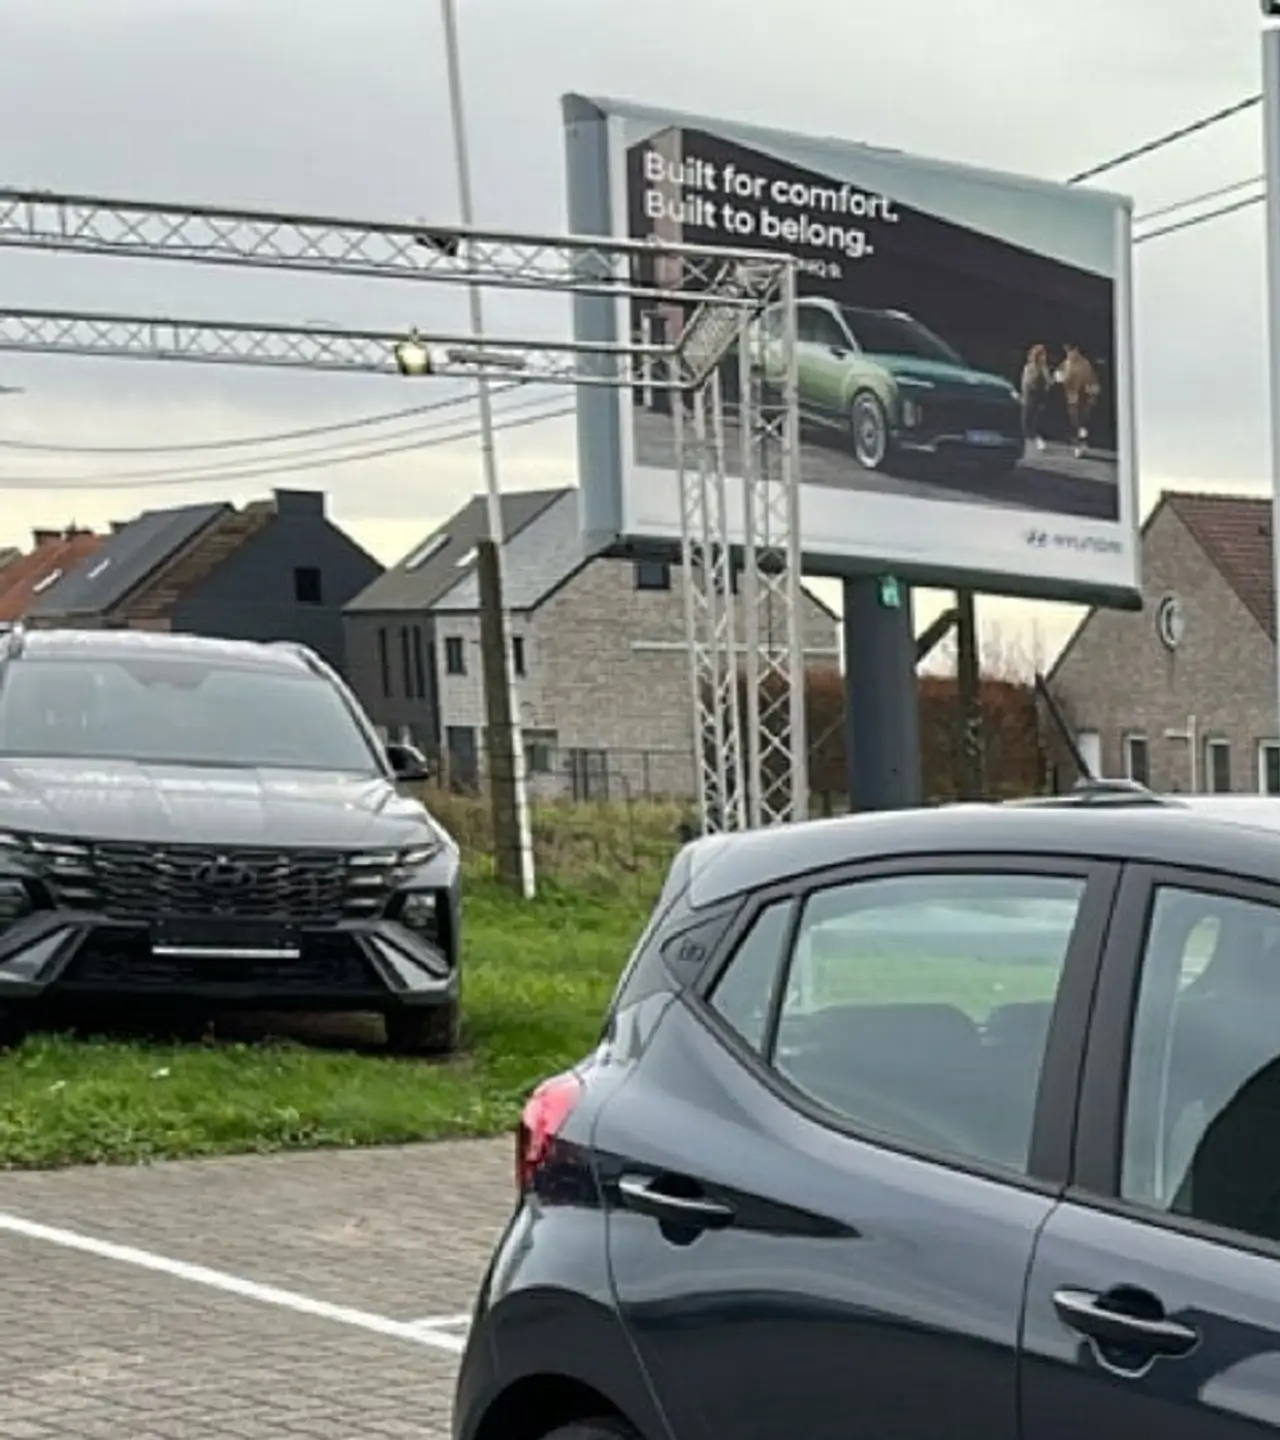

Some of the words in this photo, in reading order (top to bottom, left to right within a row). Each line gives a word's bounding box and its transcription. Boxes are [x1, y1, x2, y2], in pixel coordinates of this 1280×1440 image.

[644, 151, 716, 191] Built
[723, 163, 767, 198] for
[771, 180, 898, 222] comfort.
[644, 189, 716, 228] Built
[722, 202, 755, 234] to
[760, 207, 873, 257] belong.
